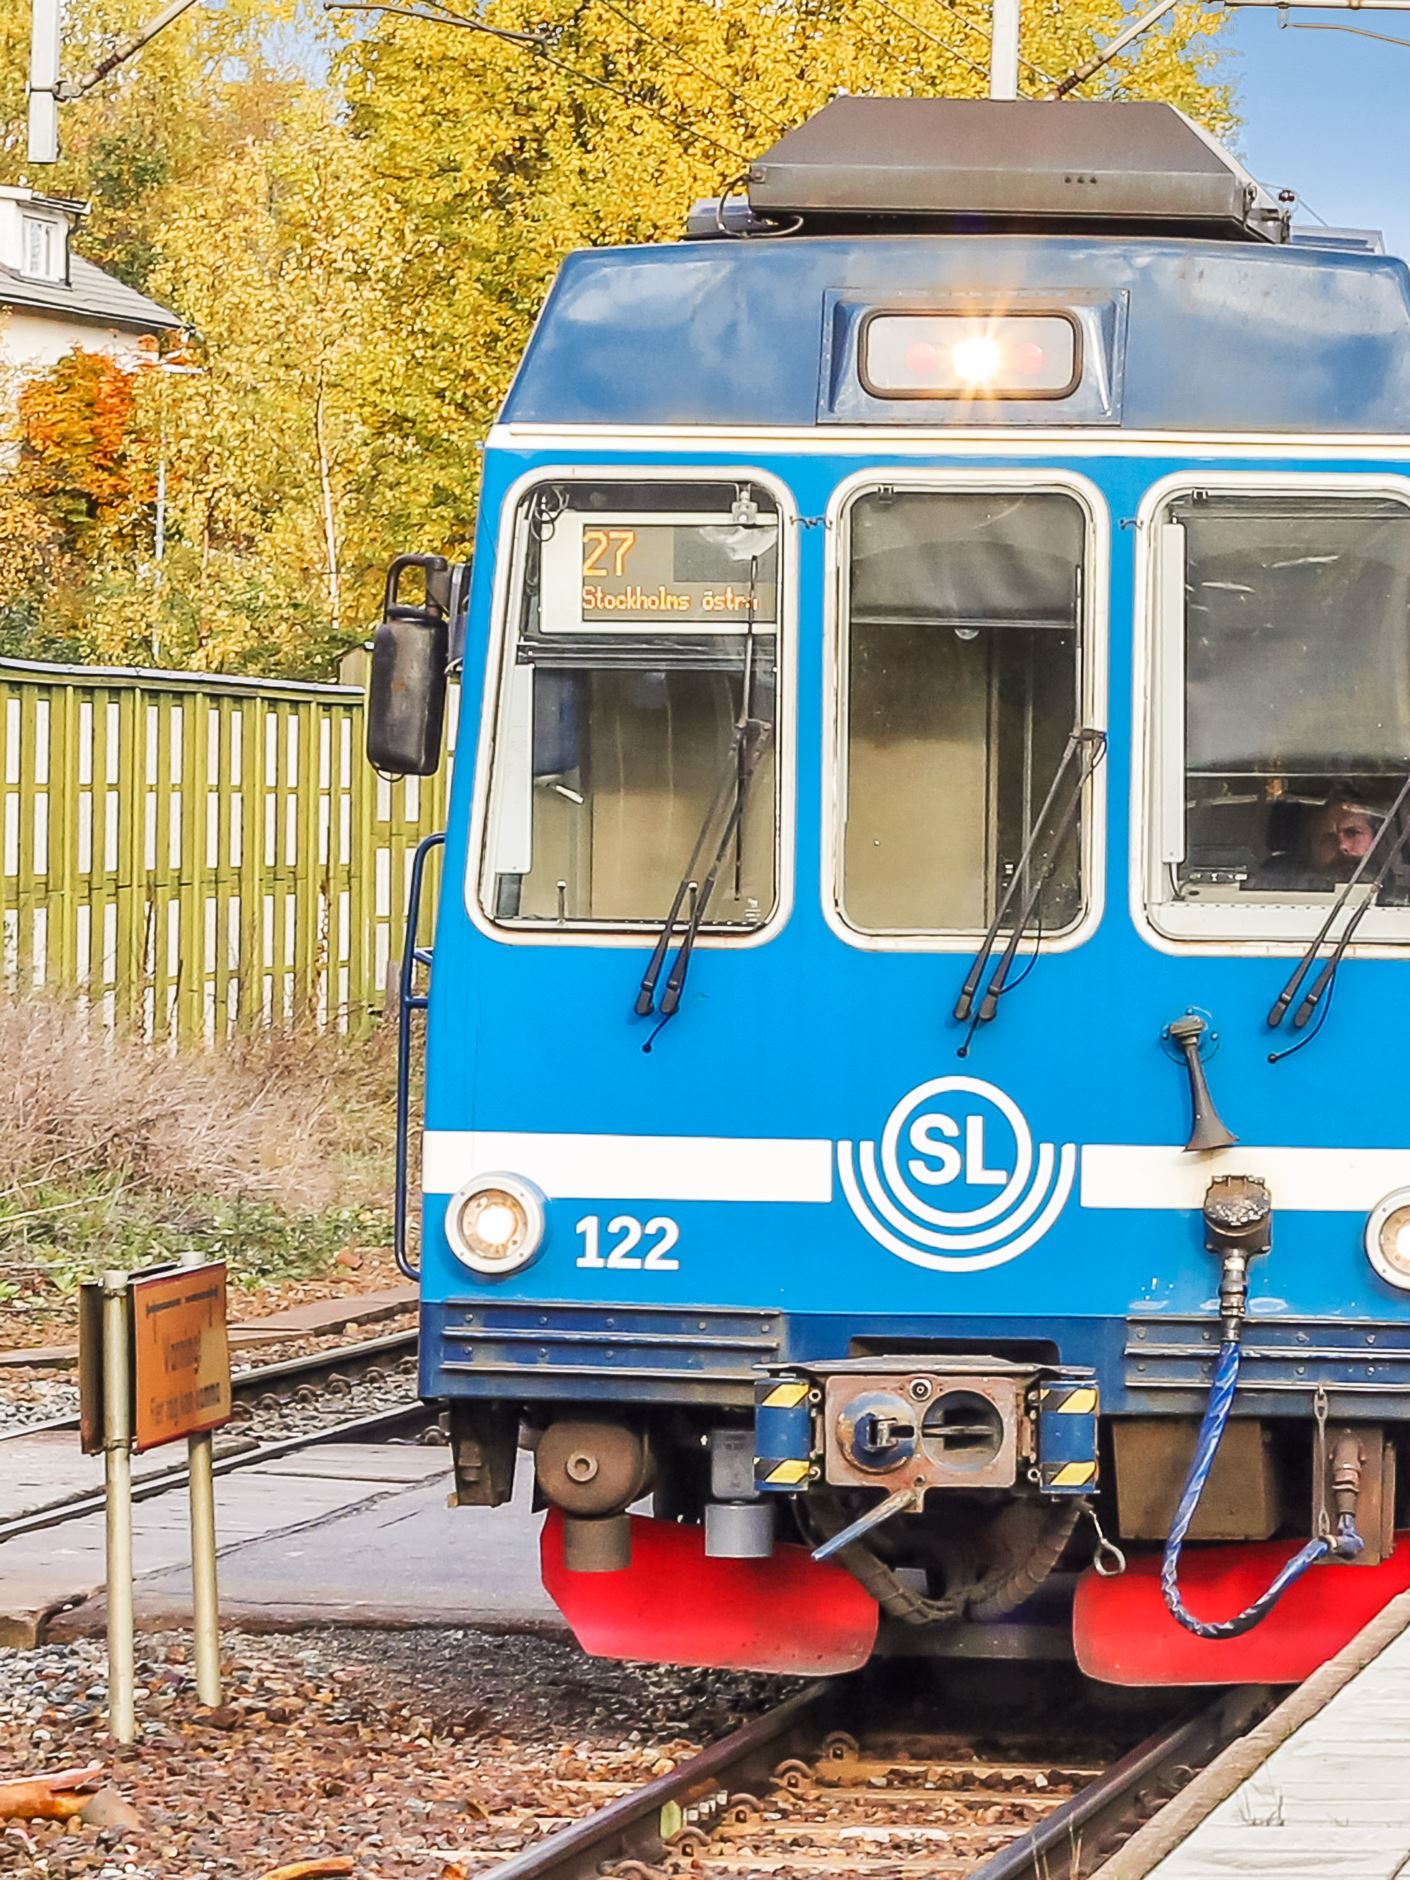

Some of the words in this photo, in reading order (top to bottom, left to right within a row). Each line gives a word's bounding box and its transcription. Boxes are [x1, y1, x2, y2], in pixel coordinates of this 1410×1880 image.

[583, 529, 636, 577] 27
[582, 586, 690, 611] Stockholms
[907, 1112, 1009, 1186] SL
[575, 1214, 681, 1271] 122
